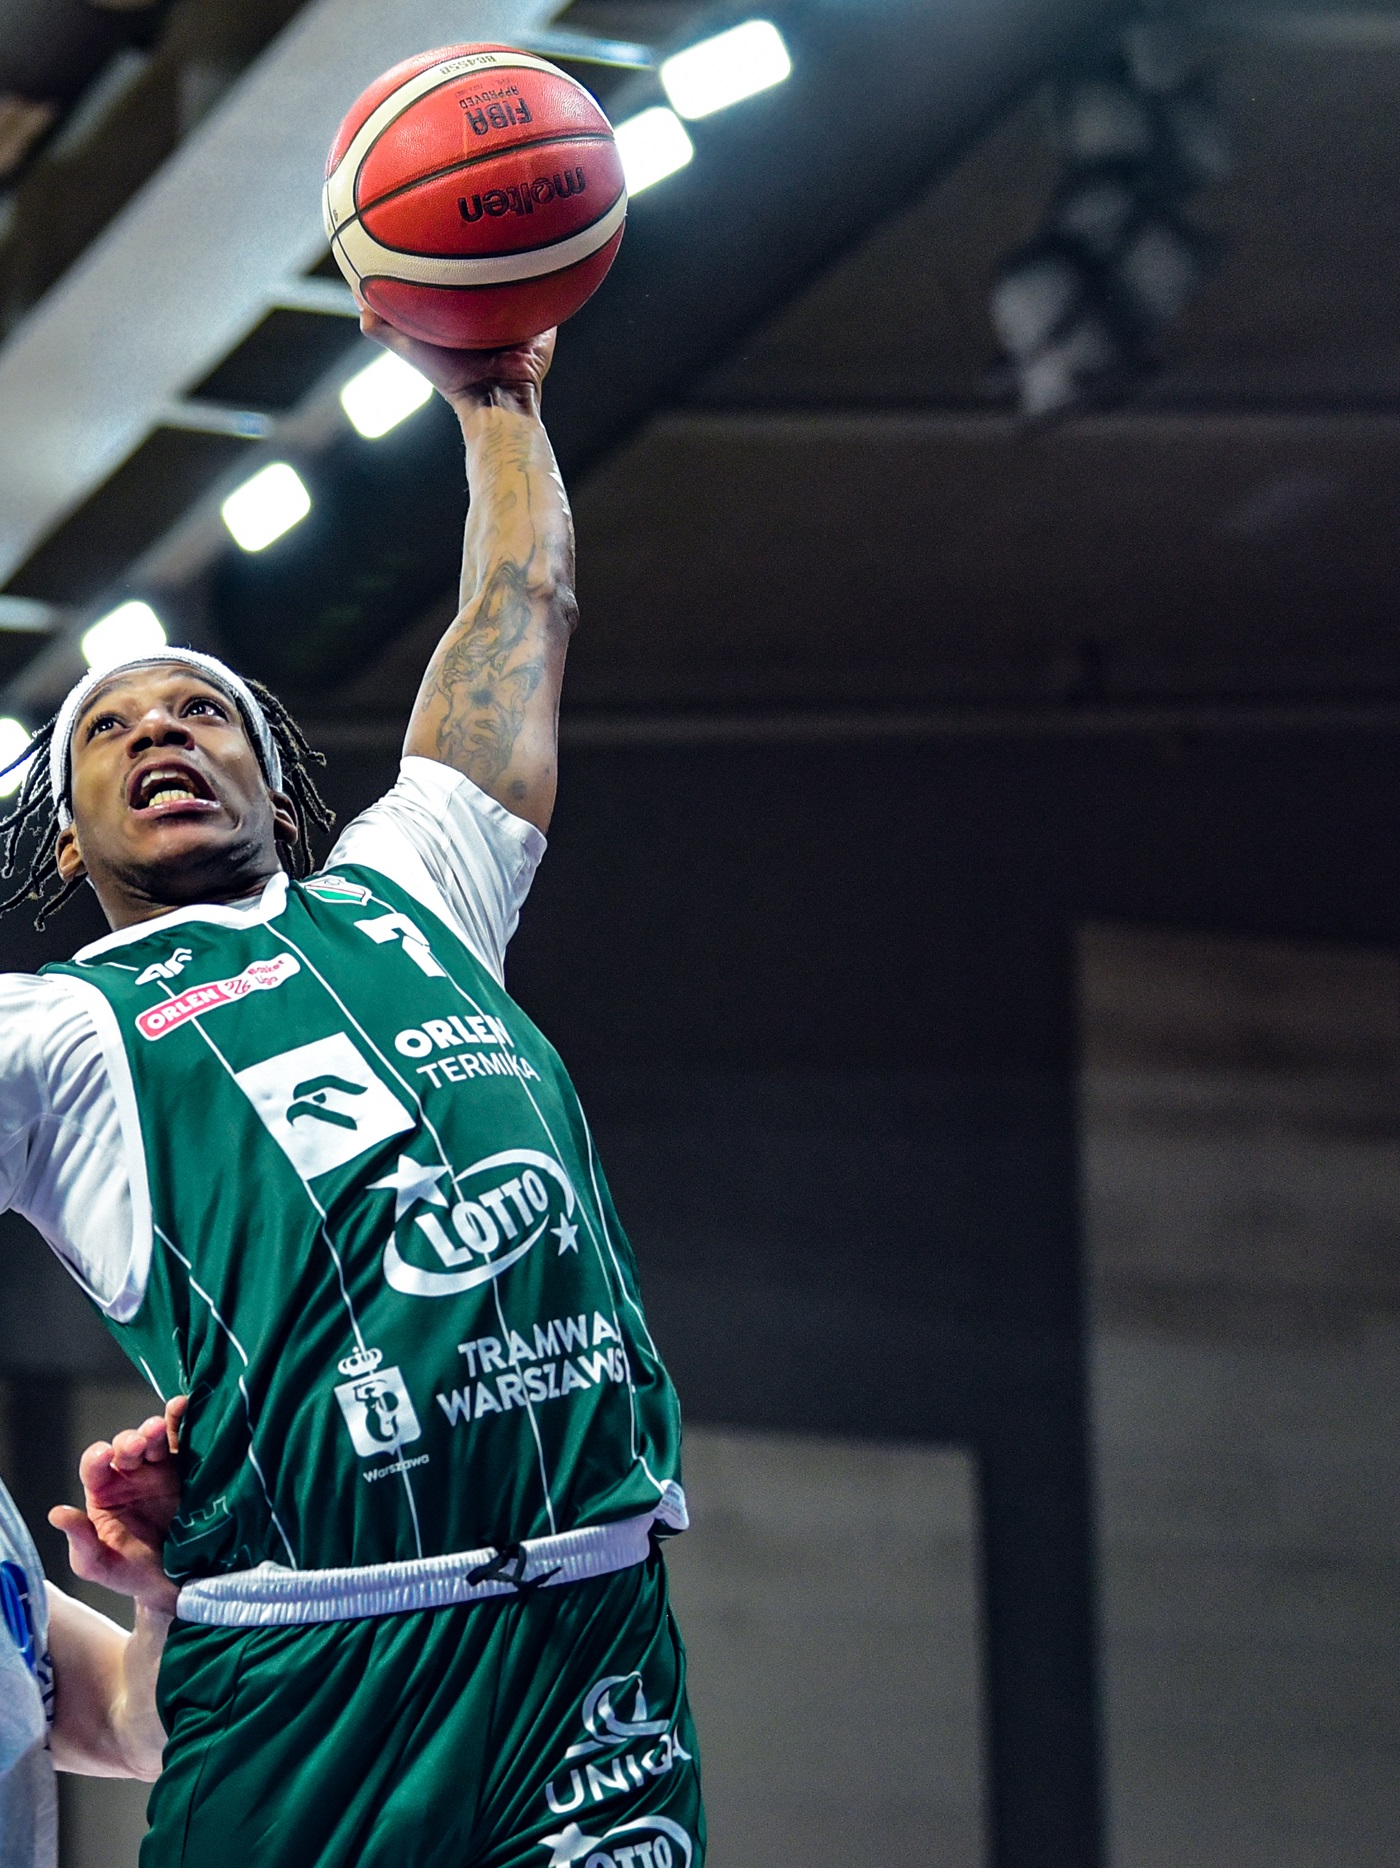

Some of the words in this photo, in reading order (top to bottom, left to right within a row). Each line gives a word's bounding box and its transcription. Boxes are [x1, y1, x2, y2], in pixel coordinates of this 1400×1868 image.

[459, 85, 519, 109] APPROVED
[465, 97, 533, 136] FIBA
[457, 167, 587, 223] molten
[354, 912, 447, 978] 7
[147, 988, 221, 1029] ORLEN
[394, 1014, 515, 1058] ORLEN
[416, 1052, 541, 1089] TERMIKA
[414, 1169, 549, 1267] LOTTO
[457, 1311, 621, 1378] TRAMWA
[436, 1347, 625, 1427] WARSZAWS
[363, 1453, 430, 1483] Warszawa
